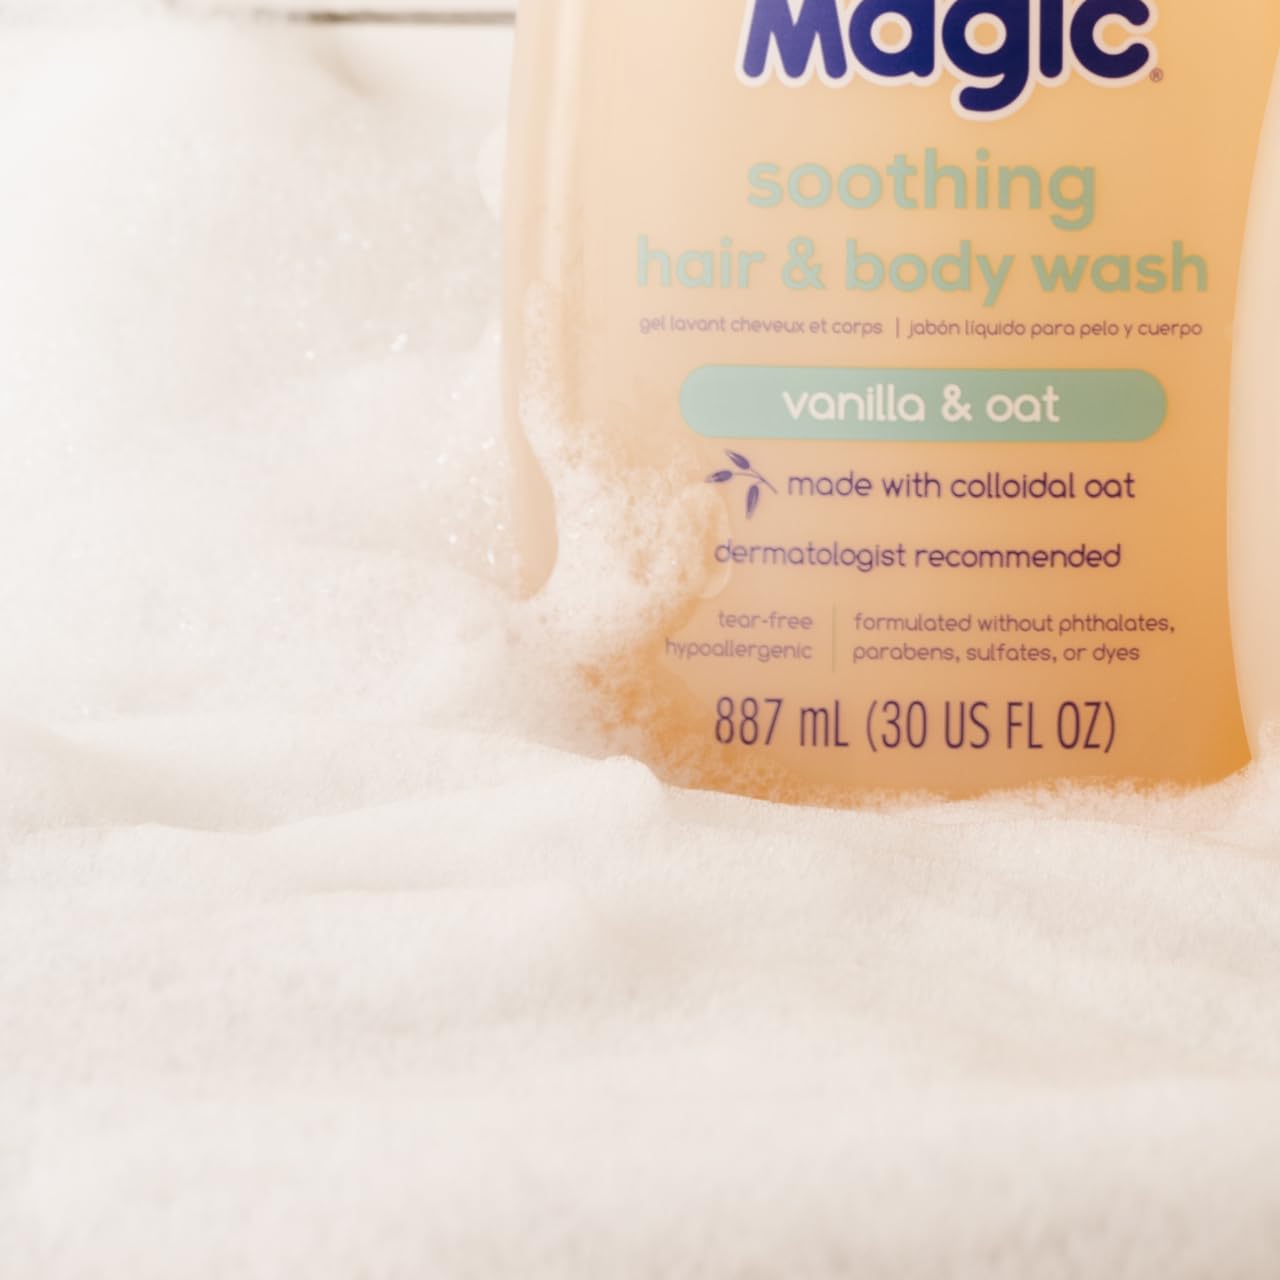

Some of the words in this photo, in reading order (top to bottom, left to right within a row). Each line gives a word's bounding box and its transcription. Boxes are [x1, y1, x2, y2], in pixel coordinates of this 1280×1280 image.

[747, 148, 1096, 231] soothing
[636, 236, 766, 289] hair
[781, 237, 826, 291] &
[845, 240, 1015, 307] body
[1031, 241, 1209, 293] wash
[640, 315, 666, 335] gel
[670, 316, 726, 332] lavant
[730, 316, 805, 334] cheveux
[809, 319, 827, 334] et
[831, 320, 883, 337] corps
[907, 318, 960, 339] jabón
[965, 319, 1027, 339] líquido
[1031, 322, 1076, 339] para
[1080, 320, 1120, 339] pelo
[1124, 323, 1133, 339] y
[1137, 322, 1202, 339] cuerpo
[782, 385, 926, 422] vanilla
[941, 386, 973, 422] &
[986, 385, 1060, 422] oat
[787, 470, 872, 497] made
[882, 472, 941, 498] with
[950, 472, 1076, 500] colloidal
[1085, 472, 1136, 500] oat
[714, 539, 907, 573] dermatologist
[915, 543, 1122, 569] recommended
[718, 610, 813, 630] tear-free
[855, 613, 972, 632] formulated
[978, 614, 1054, 633] without
[1059, 614, 1175, 636] phthalates,
[665, 639, 813, 663] hypoallergenic
[853, 642, 960, 663] parabens,
[966, 643, 1057, 663] sulfates,
[1063, 645, 1086, 661] or
[1093, 643, 1140, 664] dyes
[714, 696, 784, 745] 887
[799, 699, 849, 748] mL
[866, 699, 928, 753] (30
[945, 700, 990, 749] US
[1006, 701, 1042, 750] FL
[1057, 700, 1116, 753] OZ)
